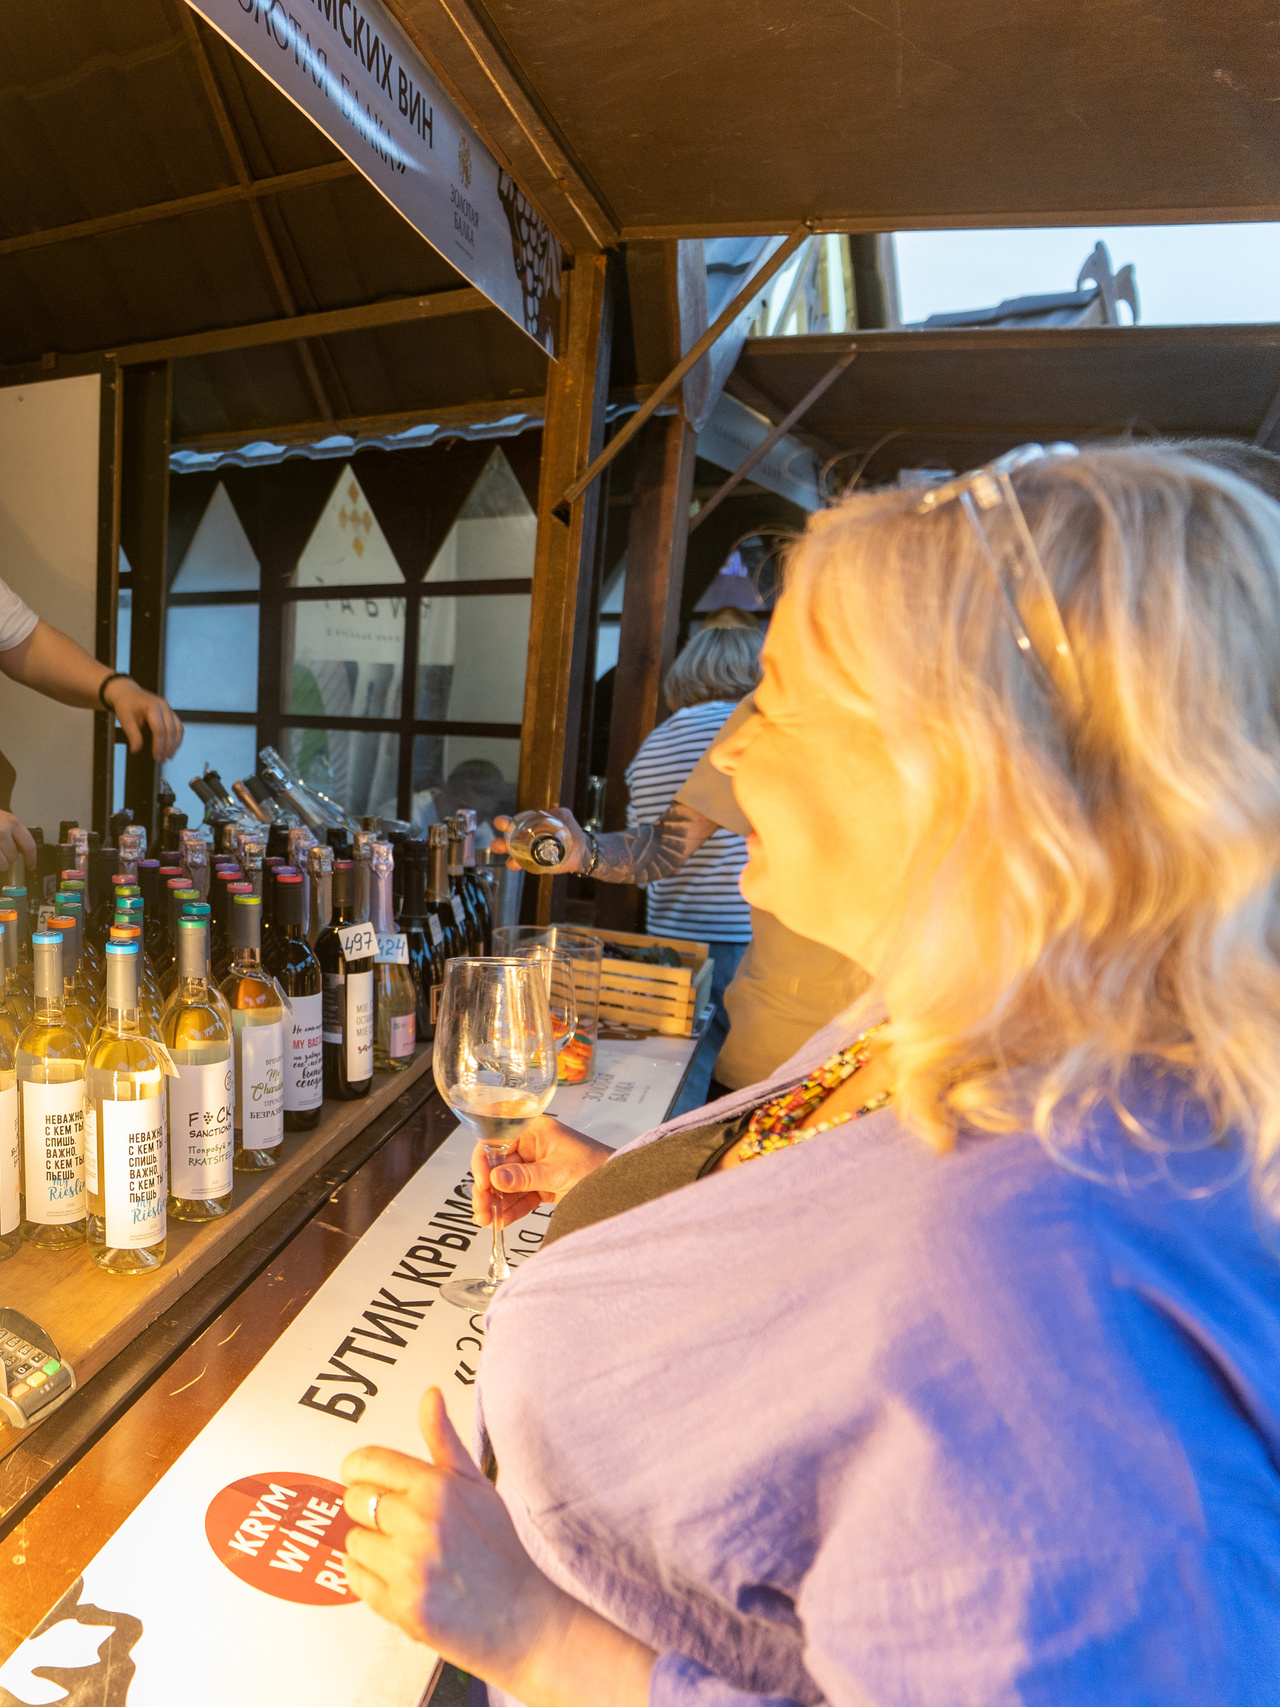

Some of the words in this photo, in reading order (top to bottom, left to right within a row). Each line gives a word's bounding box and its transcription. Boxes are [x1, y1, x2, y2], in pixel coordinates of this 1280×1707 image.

[237, 0, 329, 98] ЛОТАЯ
[307, 0, 393, 101] МСКИХ
[398, 65, 433, 150] ВИН
[344, 931, 373, 955] 497
[292, 1039, 305, 1050] MY
[45, 1126, 51, 1136] С
[54, 1124, 72, 1136] КЕМ
[74, 1121, 84, 1133] ТЫ
[189, 1122, 232, 1139] SANCTIONS
[128, 1145, 135, 1156] С
[137, 1142, 155, 1155] КЕМ
[46, 1160, 52, 1170] С
[54, 1159, 73, 1170] КЕМ
[74, 1154, 85, 1167] ТЫ
[46, 1170, 75, 1182] ПЬЕШЬ
[129, 1181, 135, 1192] С
[138, 1177, 155, 1191] КЕМ
[129, 1189, 157, 1203] ПЬЕШЬ
[297, 1286, 436, 1424] БУТИК
[227, 1482, 298, 1557] KRYM
[268, 1496, 345, 1573] WINE.
